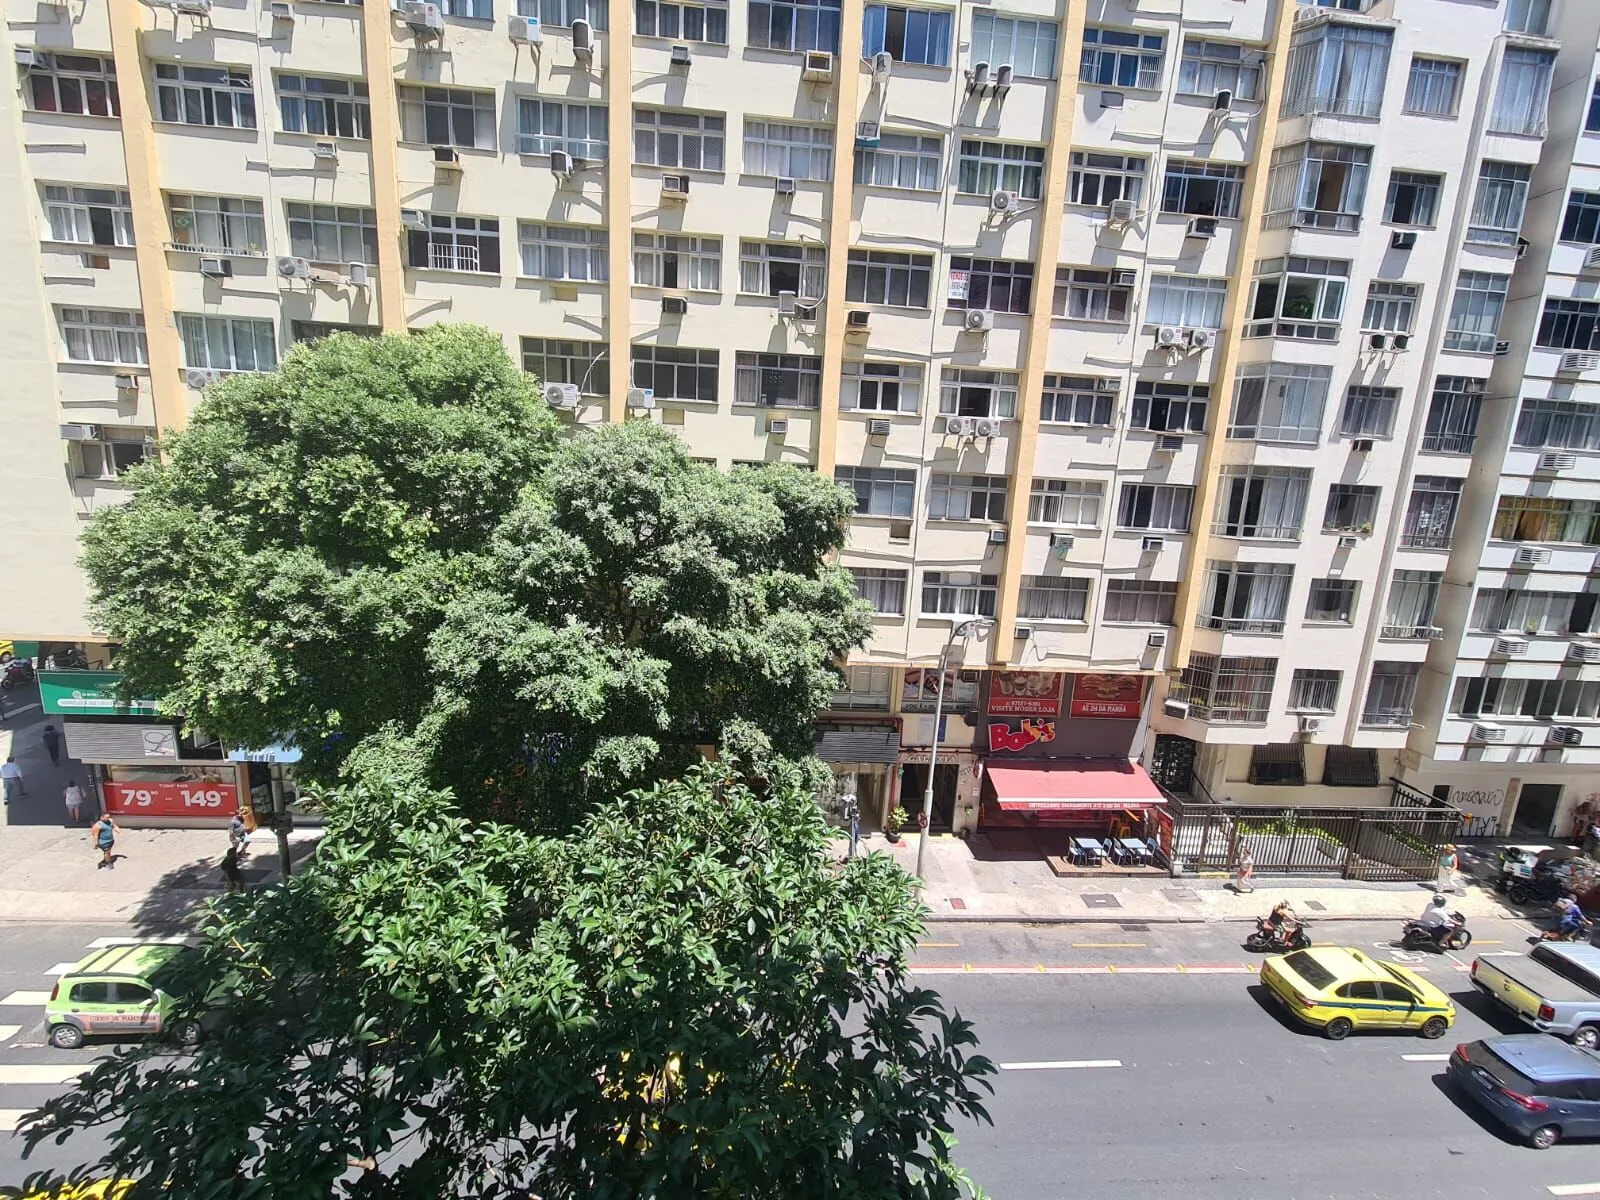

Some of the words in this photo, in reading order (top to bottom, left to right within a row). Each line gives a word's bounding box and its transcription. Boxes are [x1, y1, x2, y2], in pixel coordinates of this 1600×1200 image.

[908, 754, 956, 763] GALXIA
[120, 789, 152, 806] 79
[181, 790, 221, 807] 149
